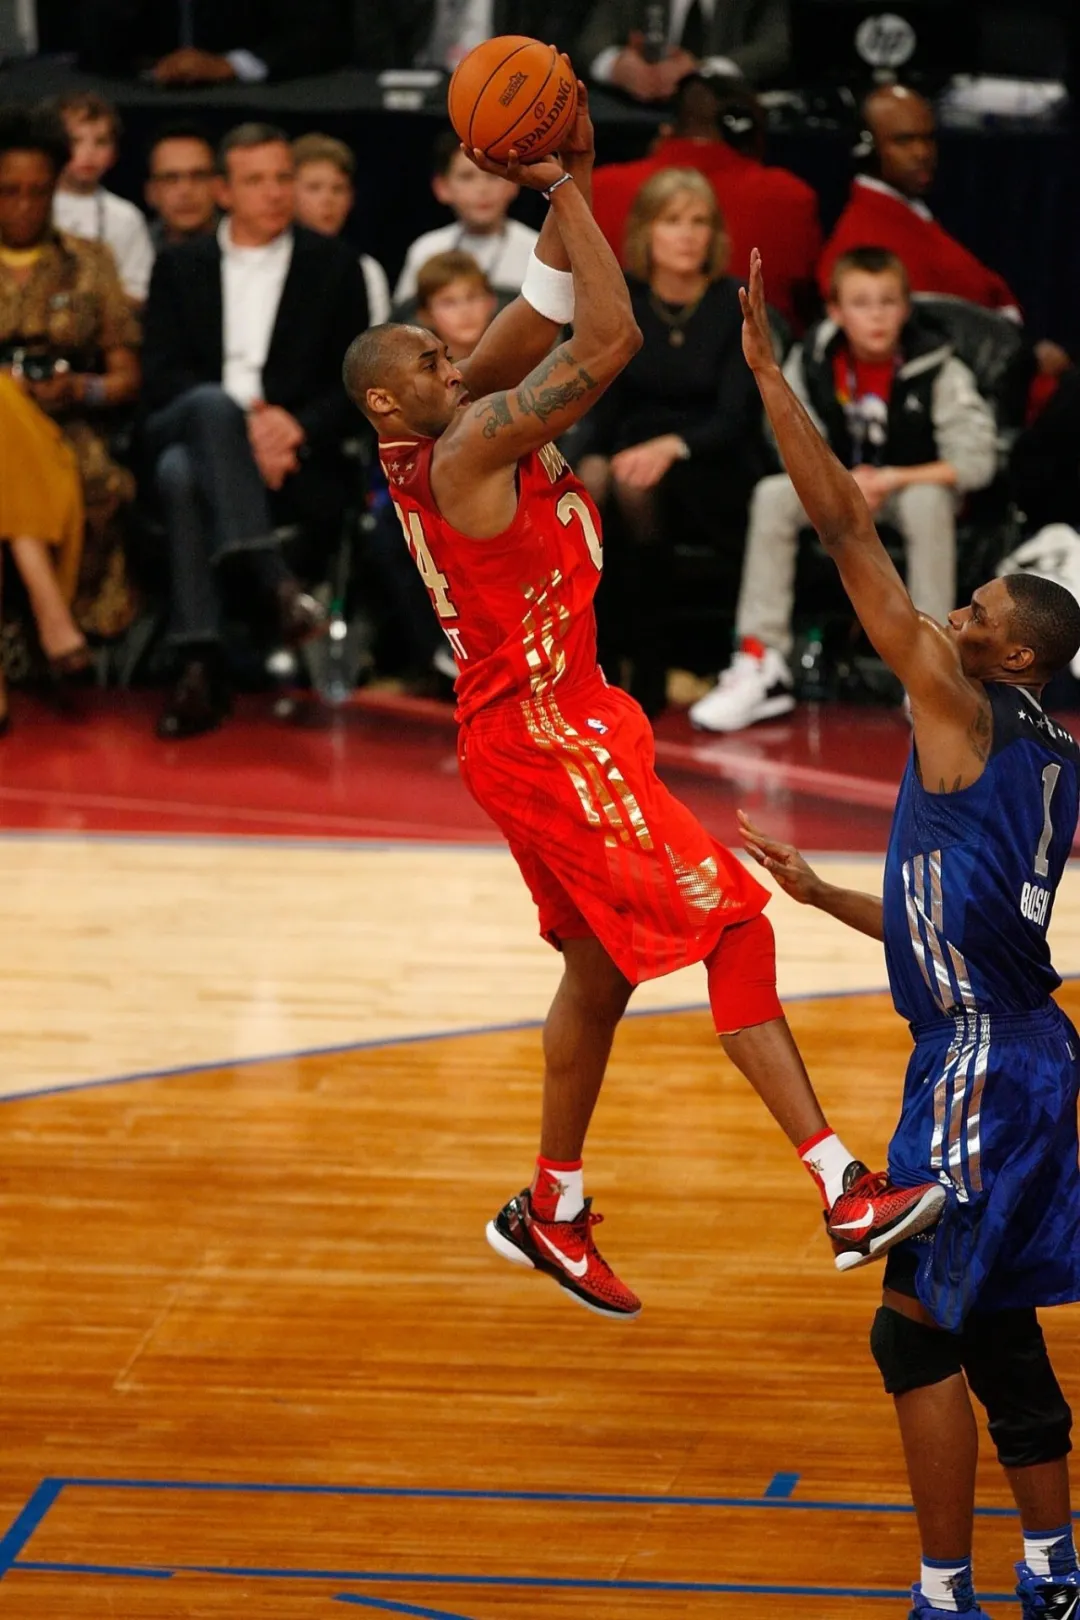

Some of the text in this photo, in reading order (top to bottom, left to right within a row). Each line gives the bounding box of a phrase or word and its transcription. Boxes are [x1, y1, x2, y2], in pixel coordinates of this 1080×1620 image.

[512, 76, 572, 153] SPALDING
[1034, 763, 1061, 878] 1
[1020, 881, 1050, 926] BOSH
